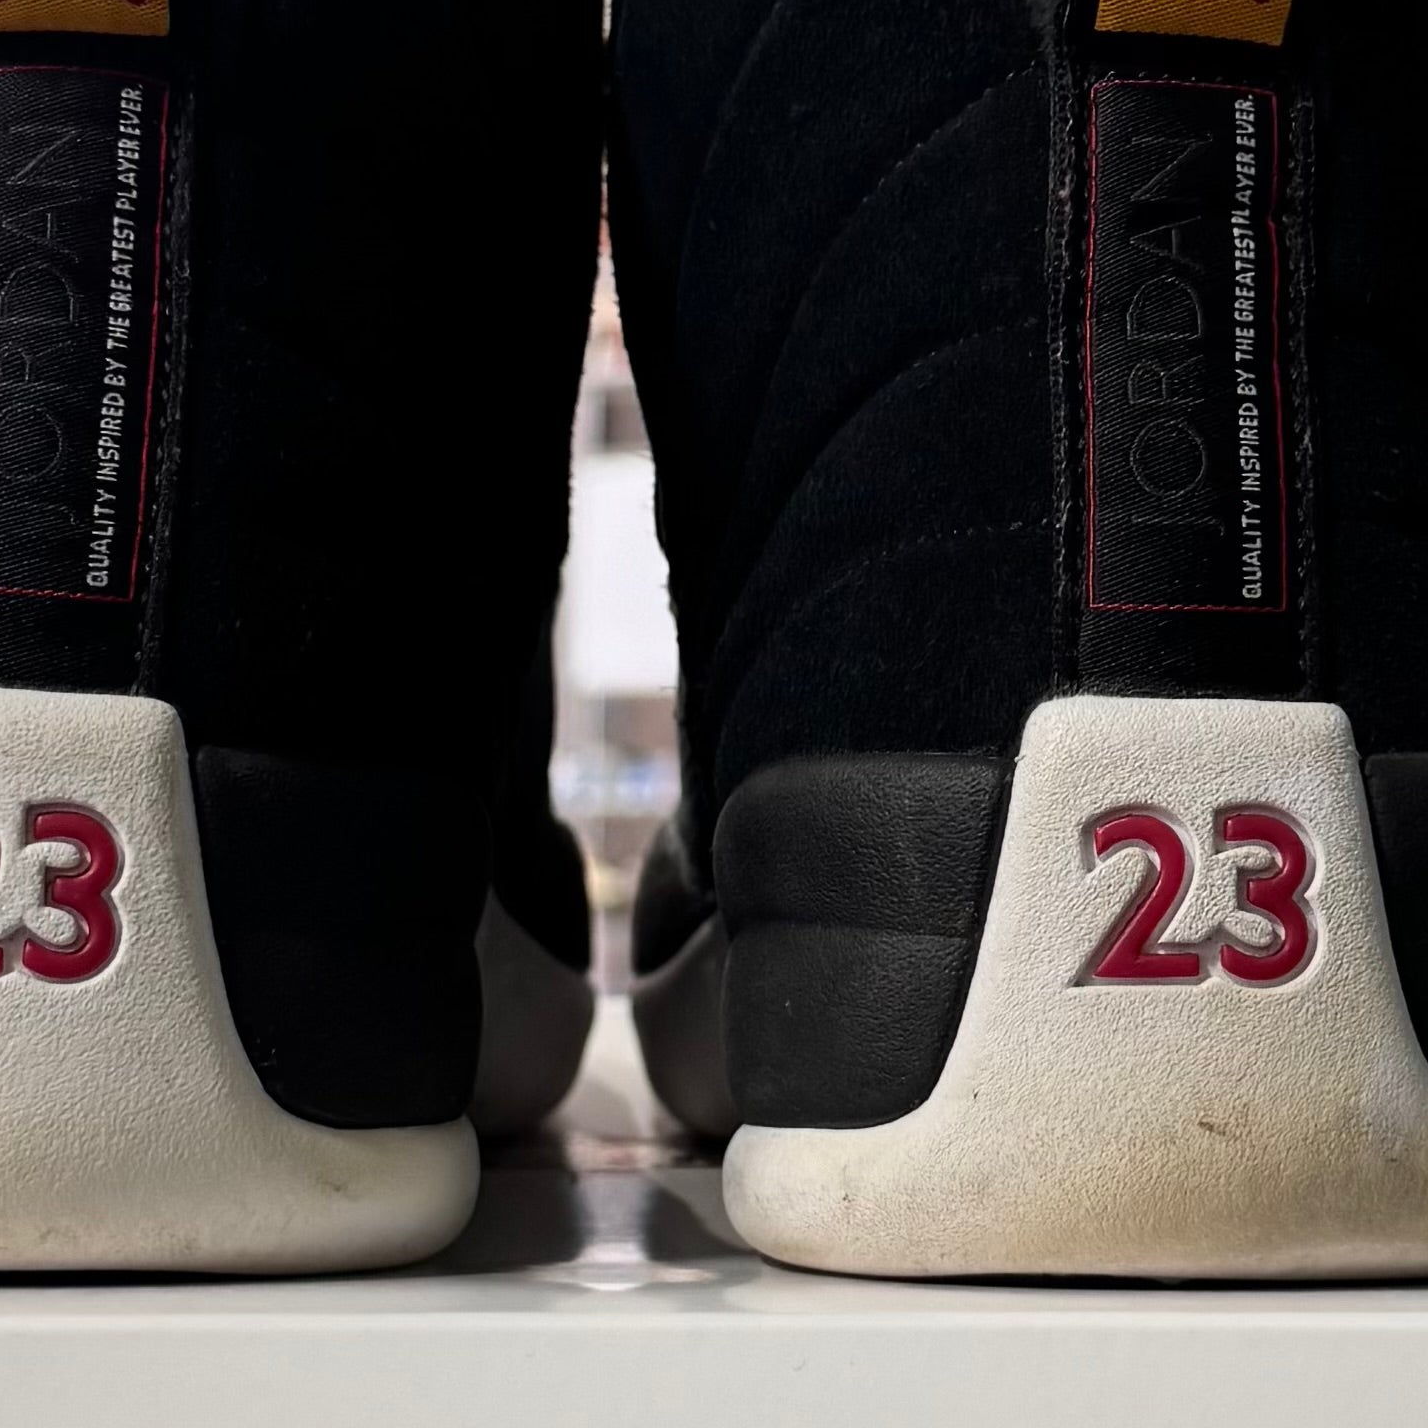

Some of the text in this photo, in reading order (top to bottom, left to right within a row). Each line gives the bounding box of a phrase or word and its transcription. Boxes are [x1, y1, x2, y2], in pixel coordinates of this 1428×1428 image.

[115, 138, 141, 211] PLAYER
[1231, 150, 1256, 225] PLAYER
[108, 215, 136, 313] GREATEST
[1233, 226, 1256, 323] GREATEST
[103, 357, 128, 387] BY
[106, 315, 132, 349] THE
[1125, 134, 1224, 538] JORDAN
[1235, 327, 1256, 362] THE
[1235, 368, 1258, 396] BY
[95, 392, 125, 482] INSPIRED
[1238, 401, 1262, 492] INSPIRED
[86, 488, 117, 587] QUALITY
[1241, 498, 1263, 599] QUALITY
[1084, 810, 1310, 984] 23
